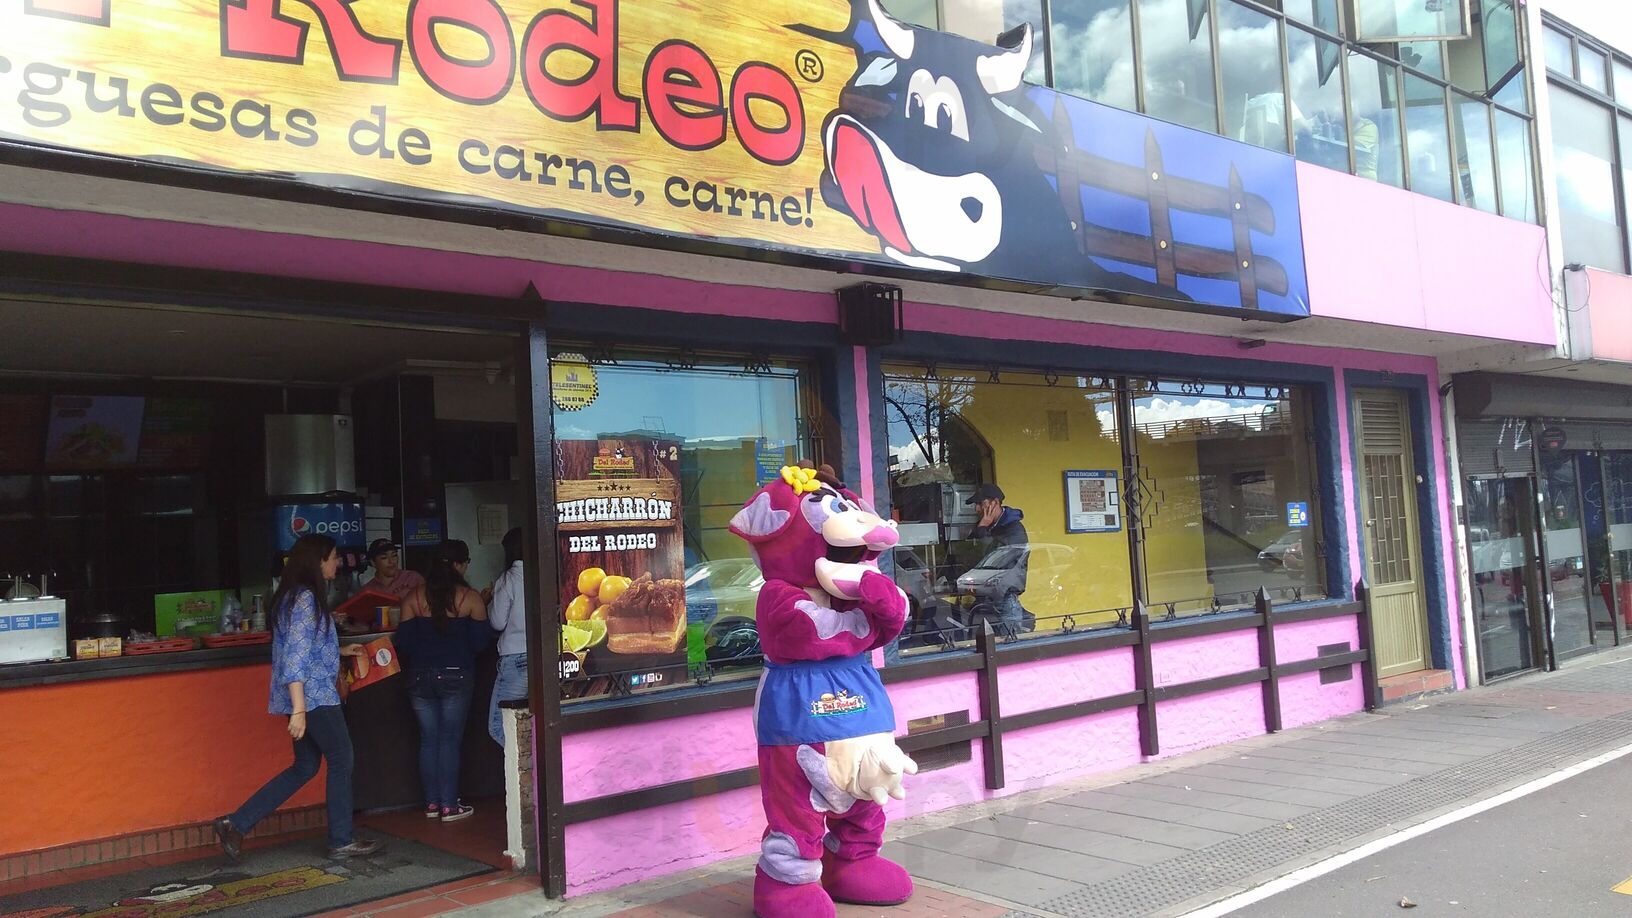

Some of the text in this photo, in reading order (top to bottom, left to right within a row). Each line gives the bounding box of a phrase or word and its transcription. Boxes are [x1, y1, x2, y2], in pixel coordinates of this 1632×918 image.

[0, 56, 814, 227] guesas de carne, carne!
[315, 519, 362, 536] pepsi
[569, 533, 657, 553] DEL RODEO
